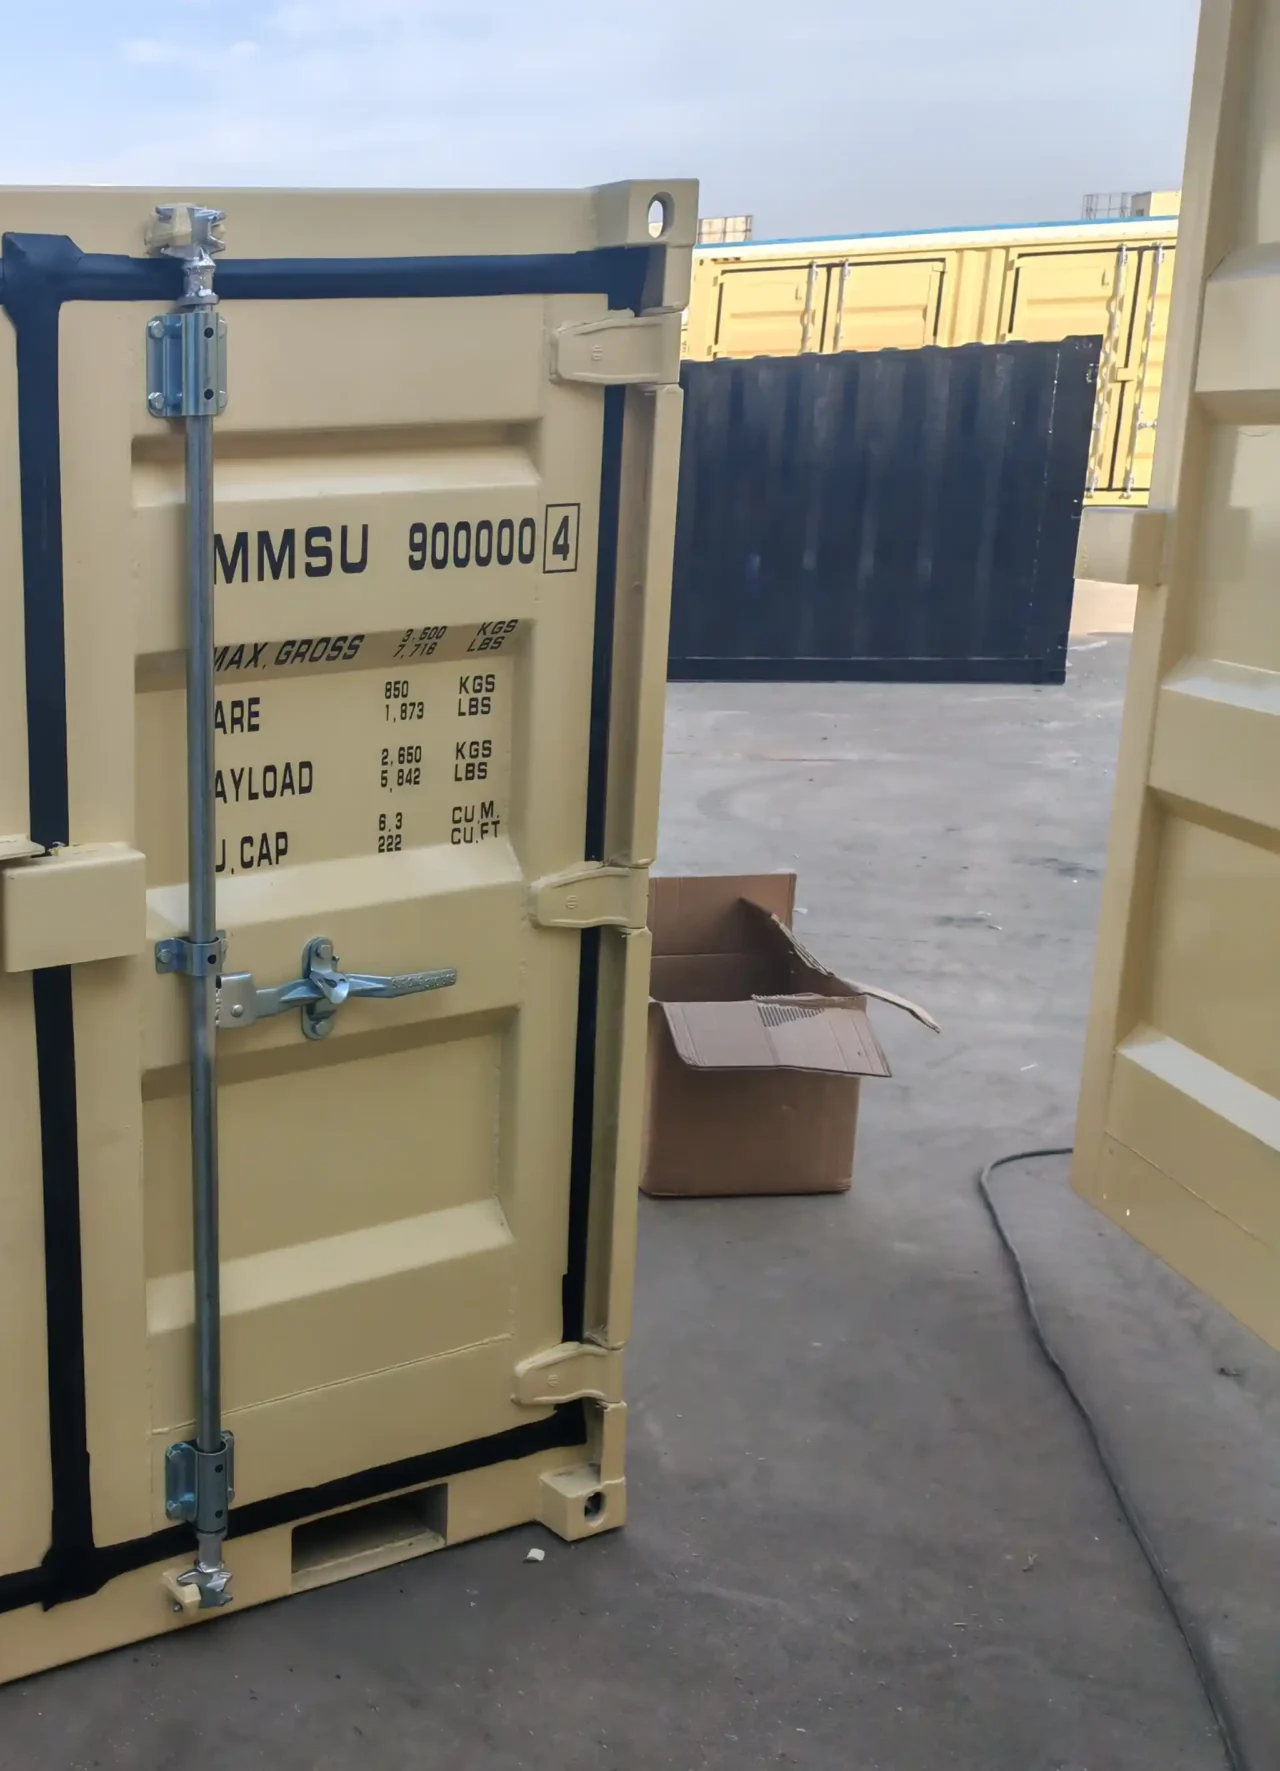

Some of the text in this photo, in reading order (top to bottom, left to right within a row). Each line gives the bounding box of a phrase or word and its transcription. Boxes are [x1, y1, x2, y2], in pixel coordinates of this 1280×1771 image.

[214, 515, 570, 585] MMSU 900000 4
[477, 619, 519, 636] KGS
[274, 634, 365, 666] GROSS
[467, 636, 505, 652] LBS
[214, 674, 496, 735] ARE 850 KGS
[385, 696, 491, 723] 1,873 LBS
[214, 739, 492, 804] AYLOAD 2,650 KGS
[380, 762, 488, 793] 5,842 LBS
[214, 831, 289, 875] U.CAP
[378, 834, 402, 853] 222
